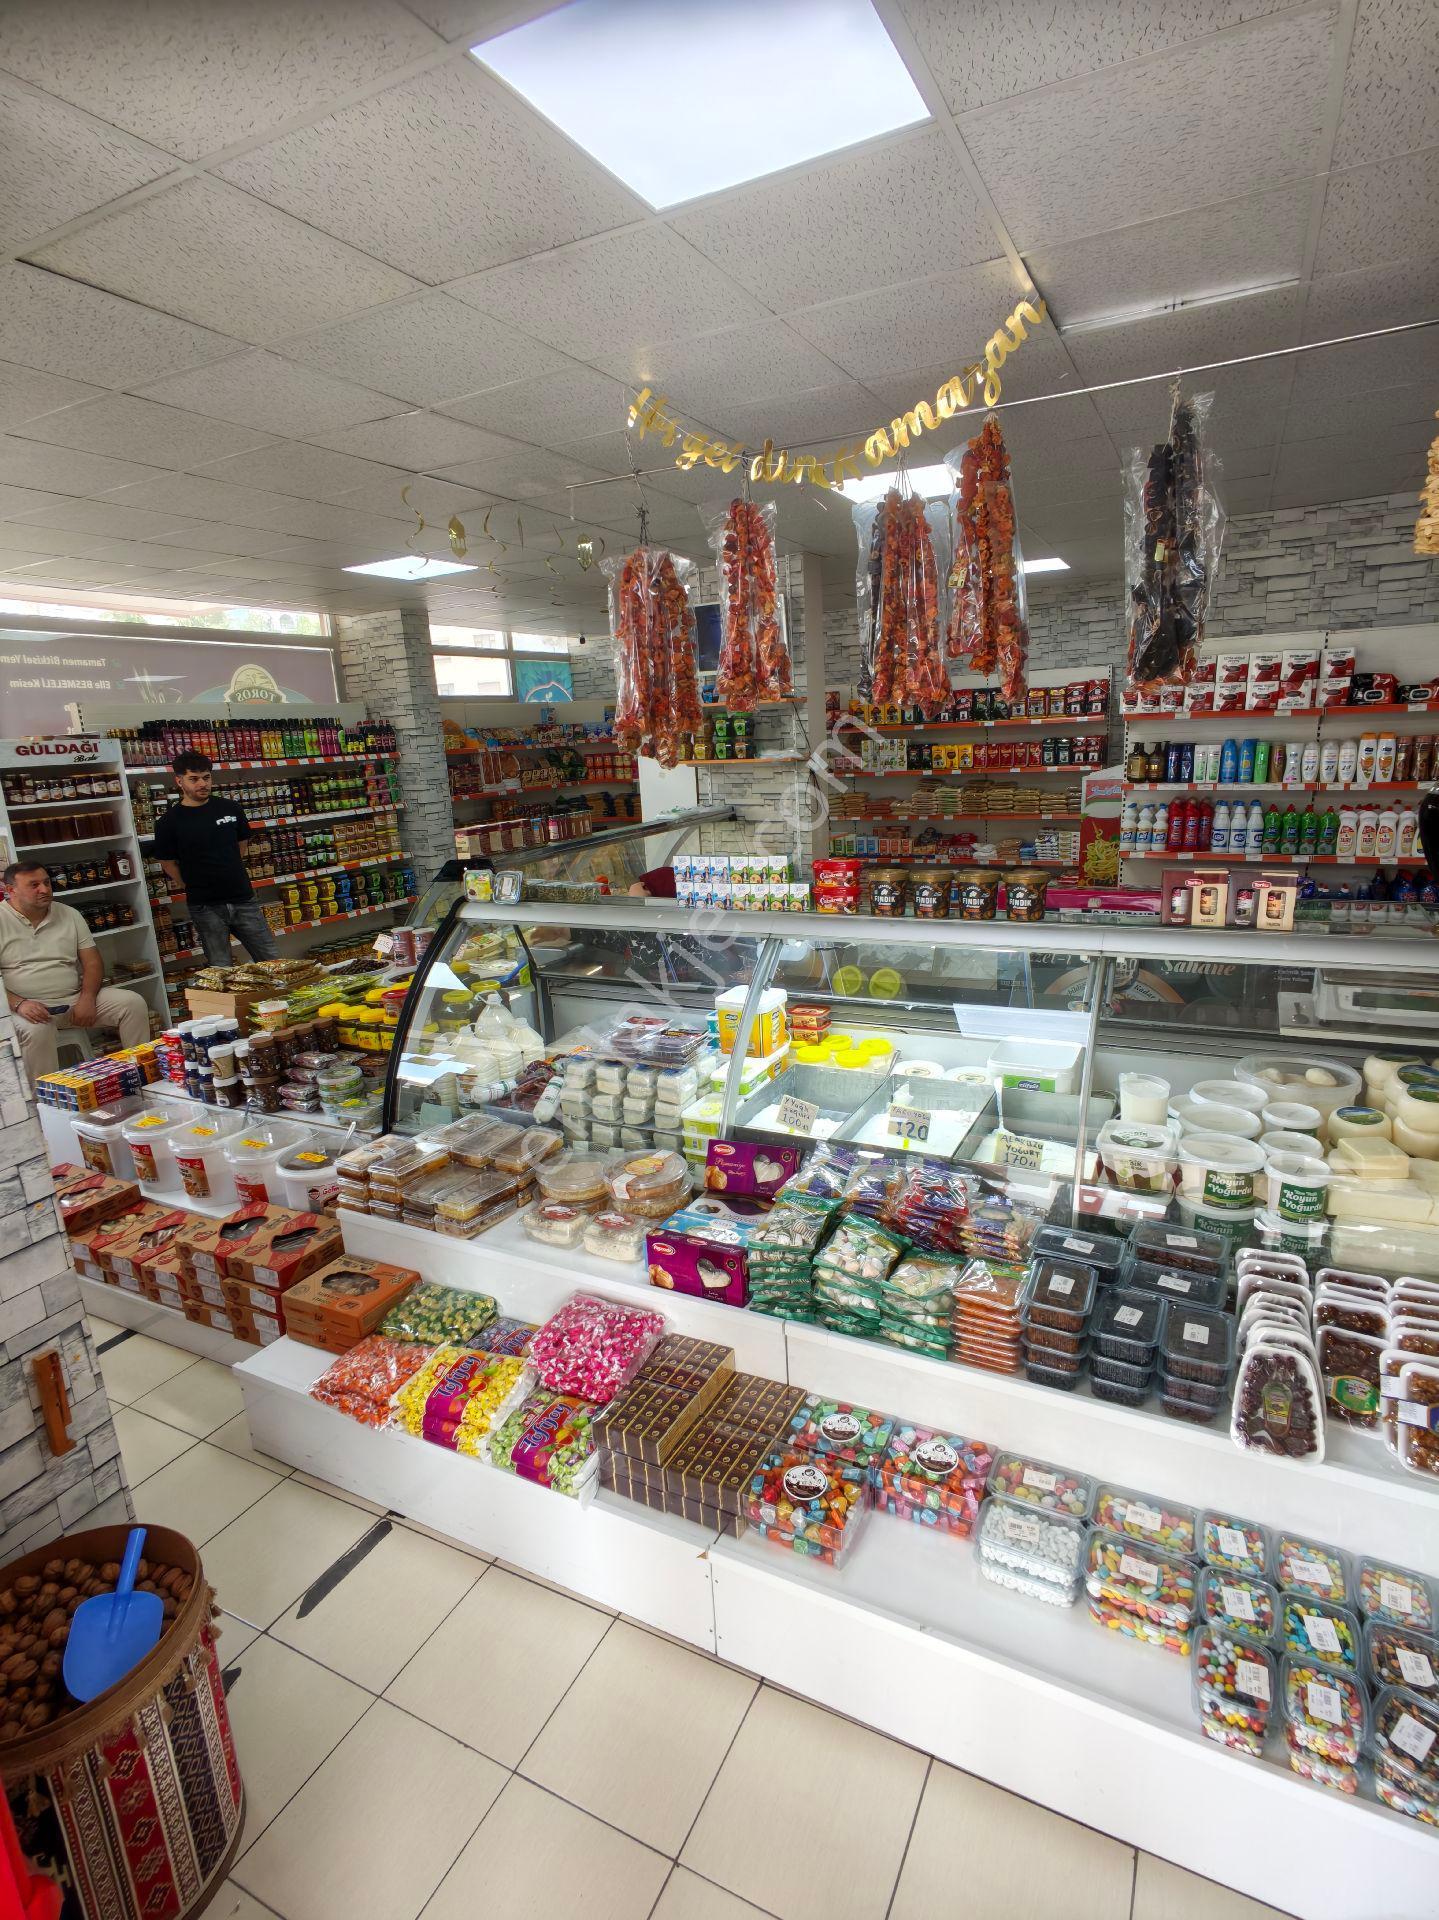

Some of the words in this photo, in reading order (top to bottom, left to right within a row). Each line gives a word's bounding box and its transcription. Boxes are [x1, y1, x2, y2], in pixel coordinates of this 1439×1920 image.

[15, 740, 99, 756] GÜLDAĞI
[1213, 833, 1224, 841] ABC
[1235, 833, 1246, 841] ABC
[896, 1121, 928, 1141] 120
[1209, 1174, 1246, 1190] Koyun
[1283, 1189, 1318, 1203] Koyun
